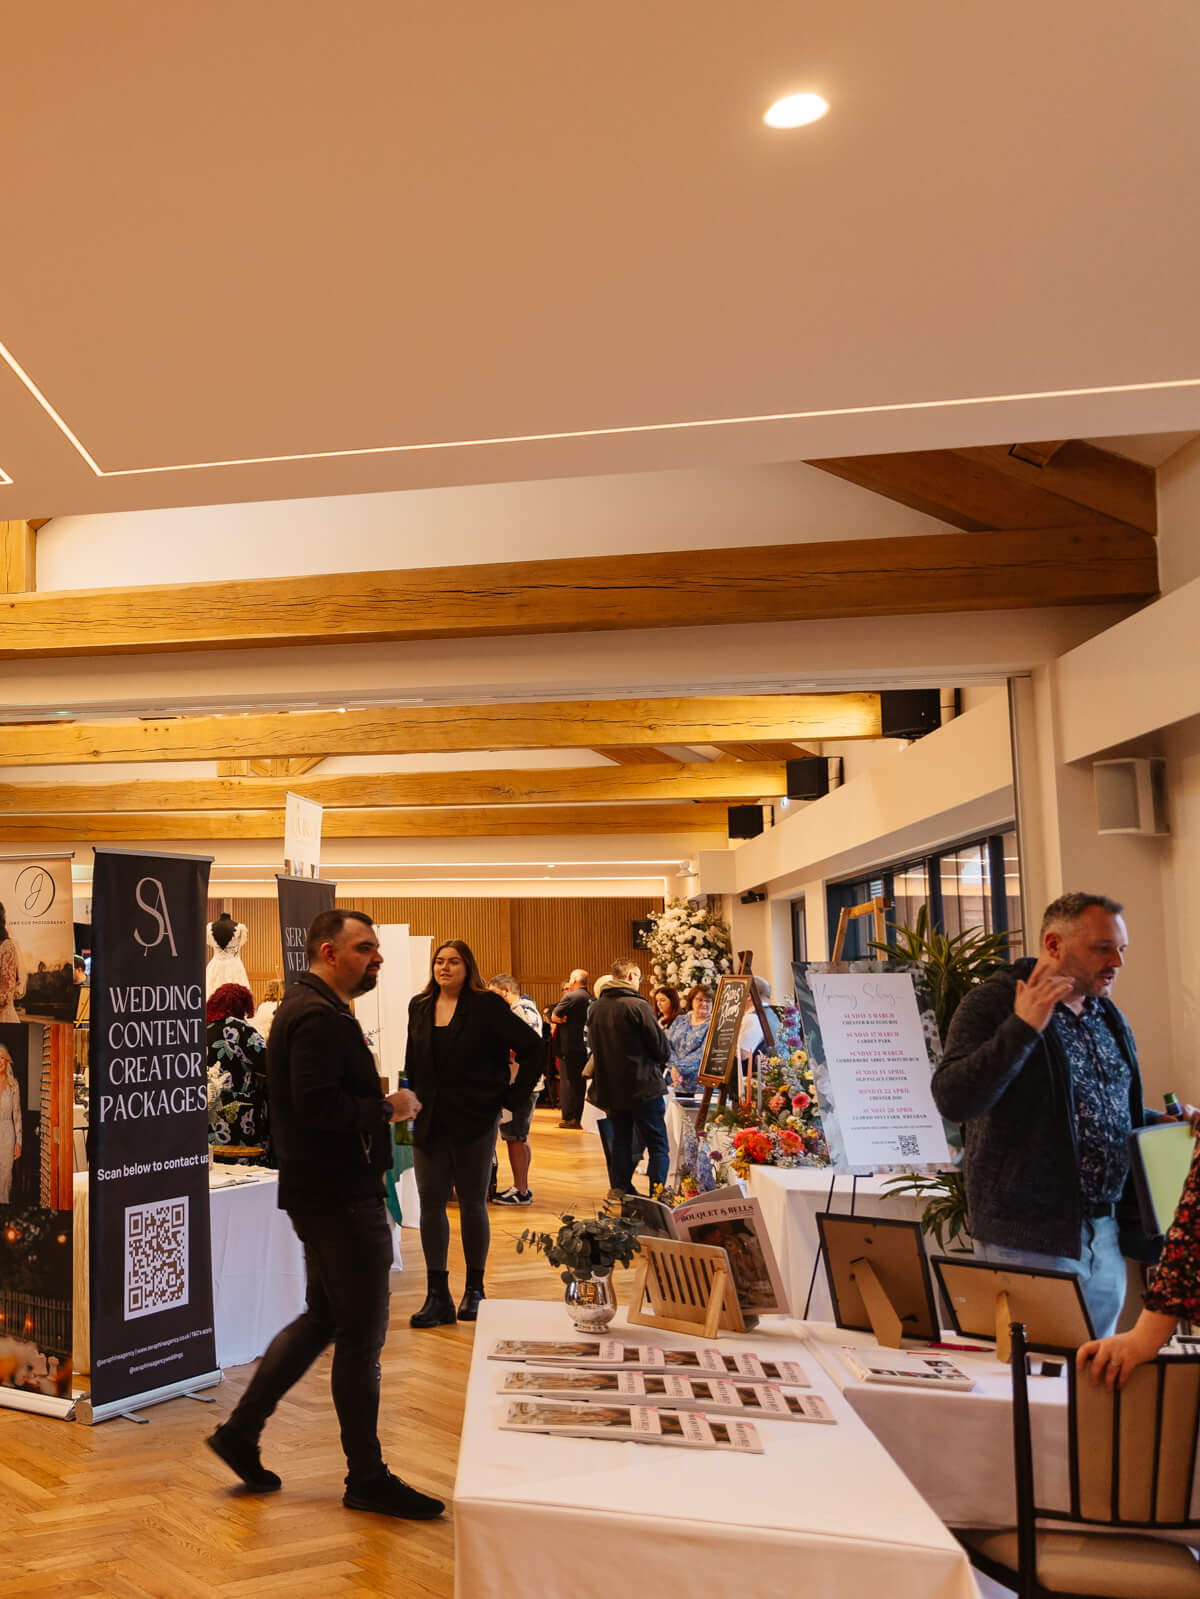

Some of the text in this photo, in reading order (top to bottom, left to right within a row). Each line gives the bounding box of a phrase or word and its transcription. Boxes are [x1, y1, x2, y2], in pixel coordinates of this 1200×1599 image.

[109, 985, 202, 1013] WEDDING
[108, 1018, 202, 1049] CONTENT
[108, 1052, 202, 1085] CREATOR
[99, 1085, 208, 1123] PACKAGES
[97, 1154, 209, 1181] Scan below to contact us
[681, 1209, 718, 1222] BOUQUET
